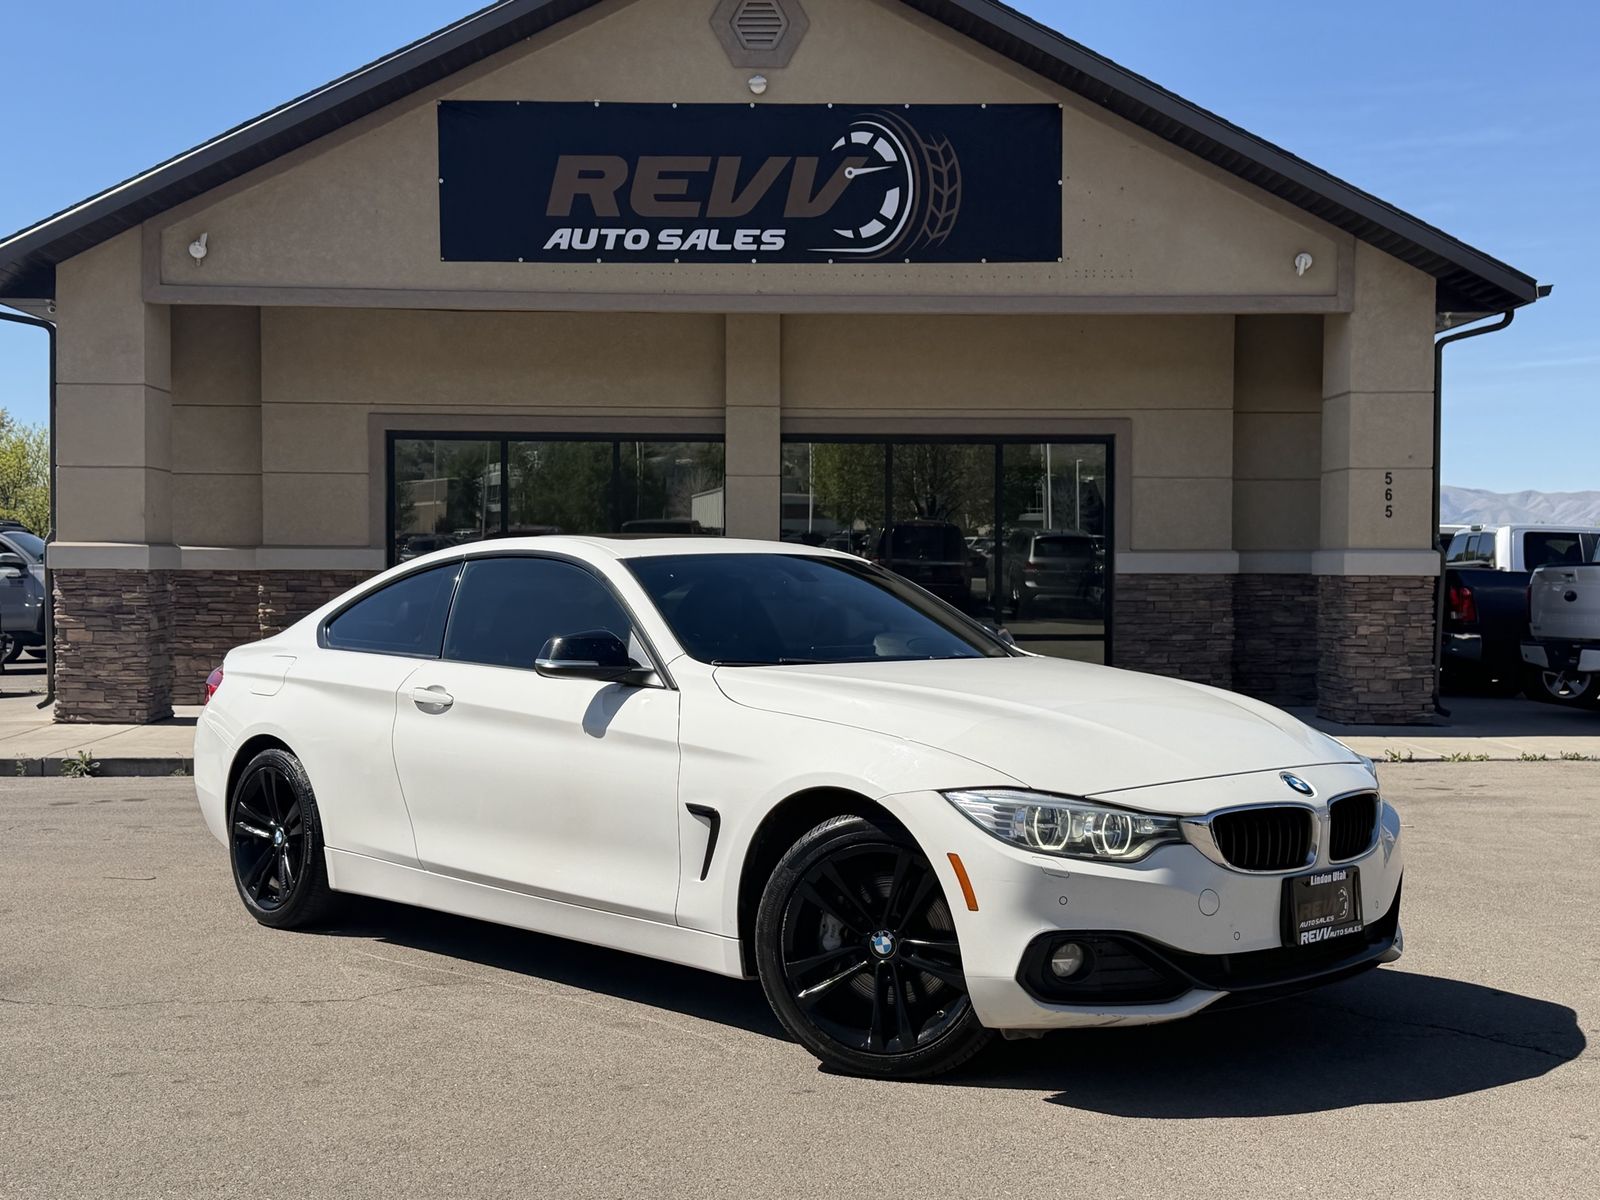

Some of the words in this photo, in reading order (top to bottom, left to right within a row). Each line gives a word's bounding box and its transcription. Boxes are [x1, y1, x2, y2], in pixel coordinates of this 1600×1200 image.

[546, 155, 868, 217] REVV
[543, 228, 650, 250] AUTO
[657, 229, 786, 250] SALES
[1385, 472, 1393, 518] 565
[1311, 874, 1331, 885] Lindon
[1333, 870, 1346, 881] Utah
[1301, 927, 1332, 945] REVV
[1329, 929, 1344, 938] AUTO
[1344, 925, 1362, 934] SALES
